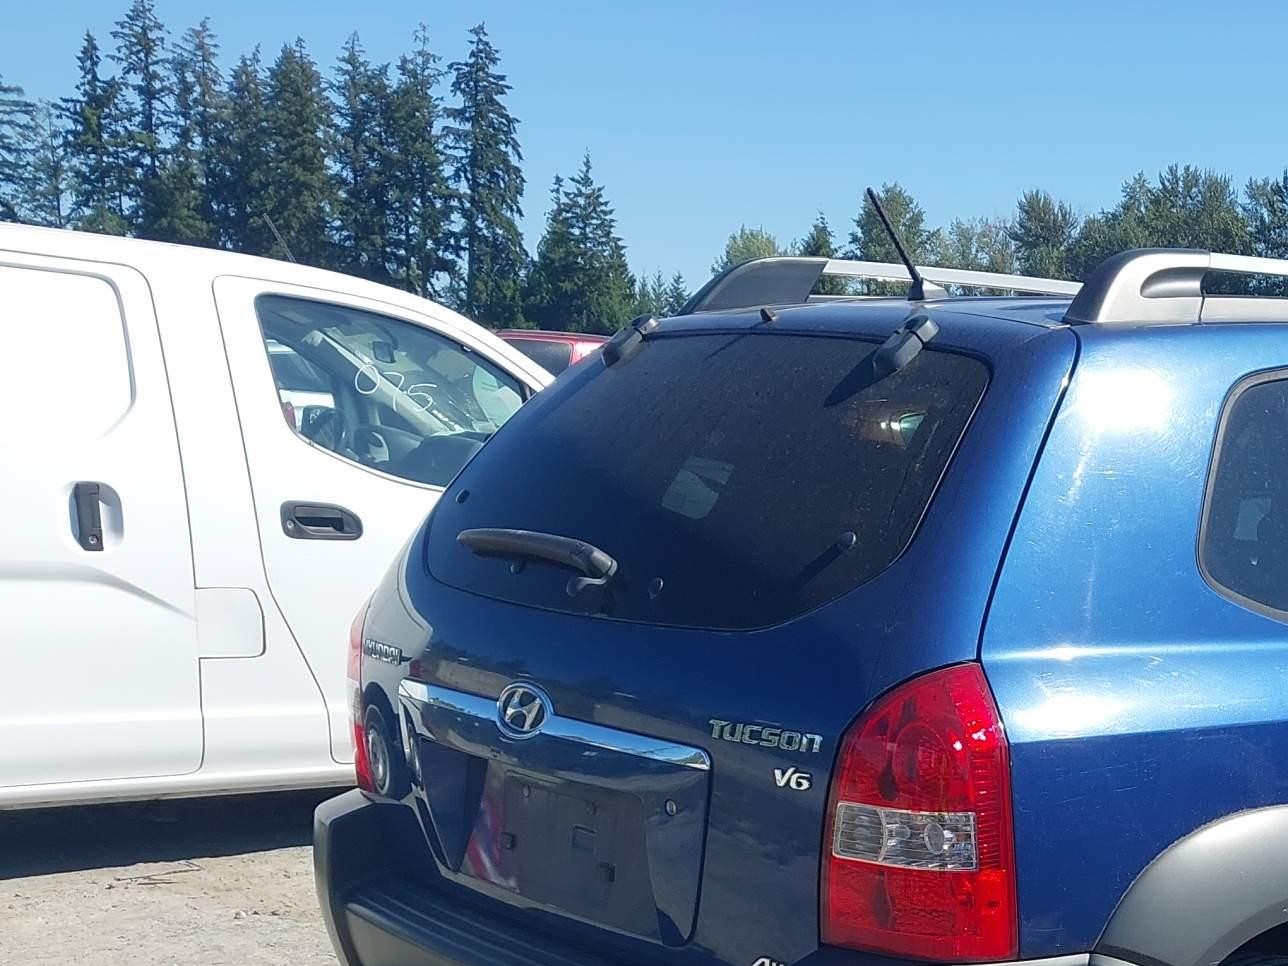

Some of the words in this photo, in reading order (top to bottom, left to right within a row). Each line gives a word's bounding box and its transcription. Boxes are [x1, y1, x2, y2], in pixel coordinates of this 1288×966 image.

[355, 365, 438, 412] 075
[708, 719, 823, 753] TUCSON
[773, 767, 811, 791] V6
